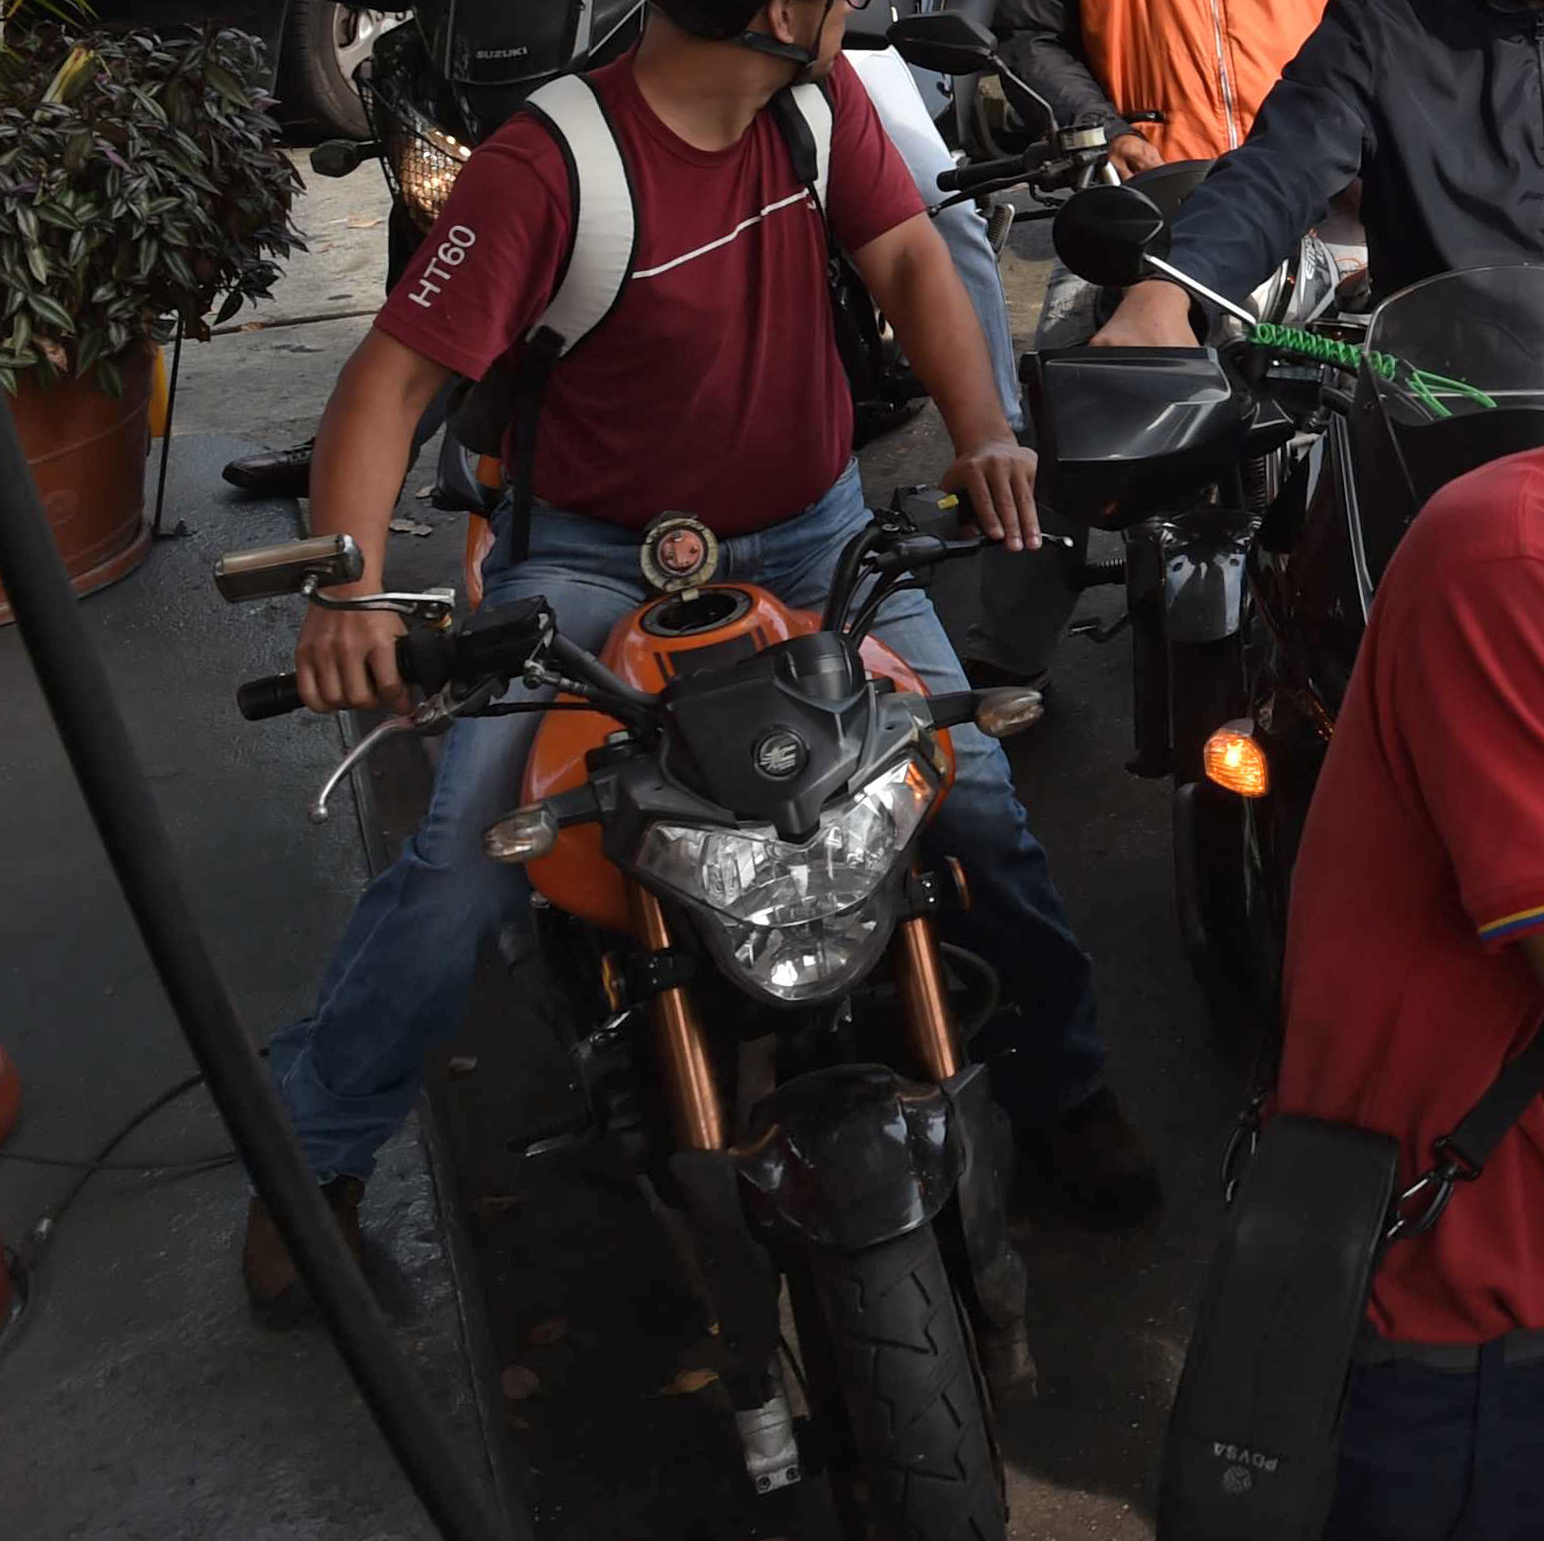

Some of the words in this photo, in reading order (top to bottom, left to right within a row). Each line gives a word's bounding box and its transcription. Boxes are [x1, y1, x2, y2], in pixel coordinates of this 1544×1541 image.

[476, 46, 528, 59] SUZUKI
[407, 225, 477, 308] HT60
[1213, 1441, 1279, 1472] PDVSA
